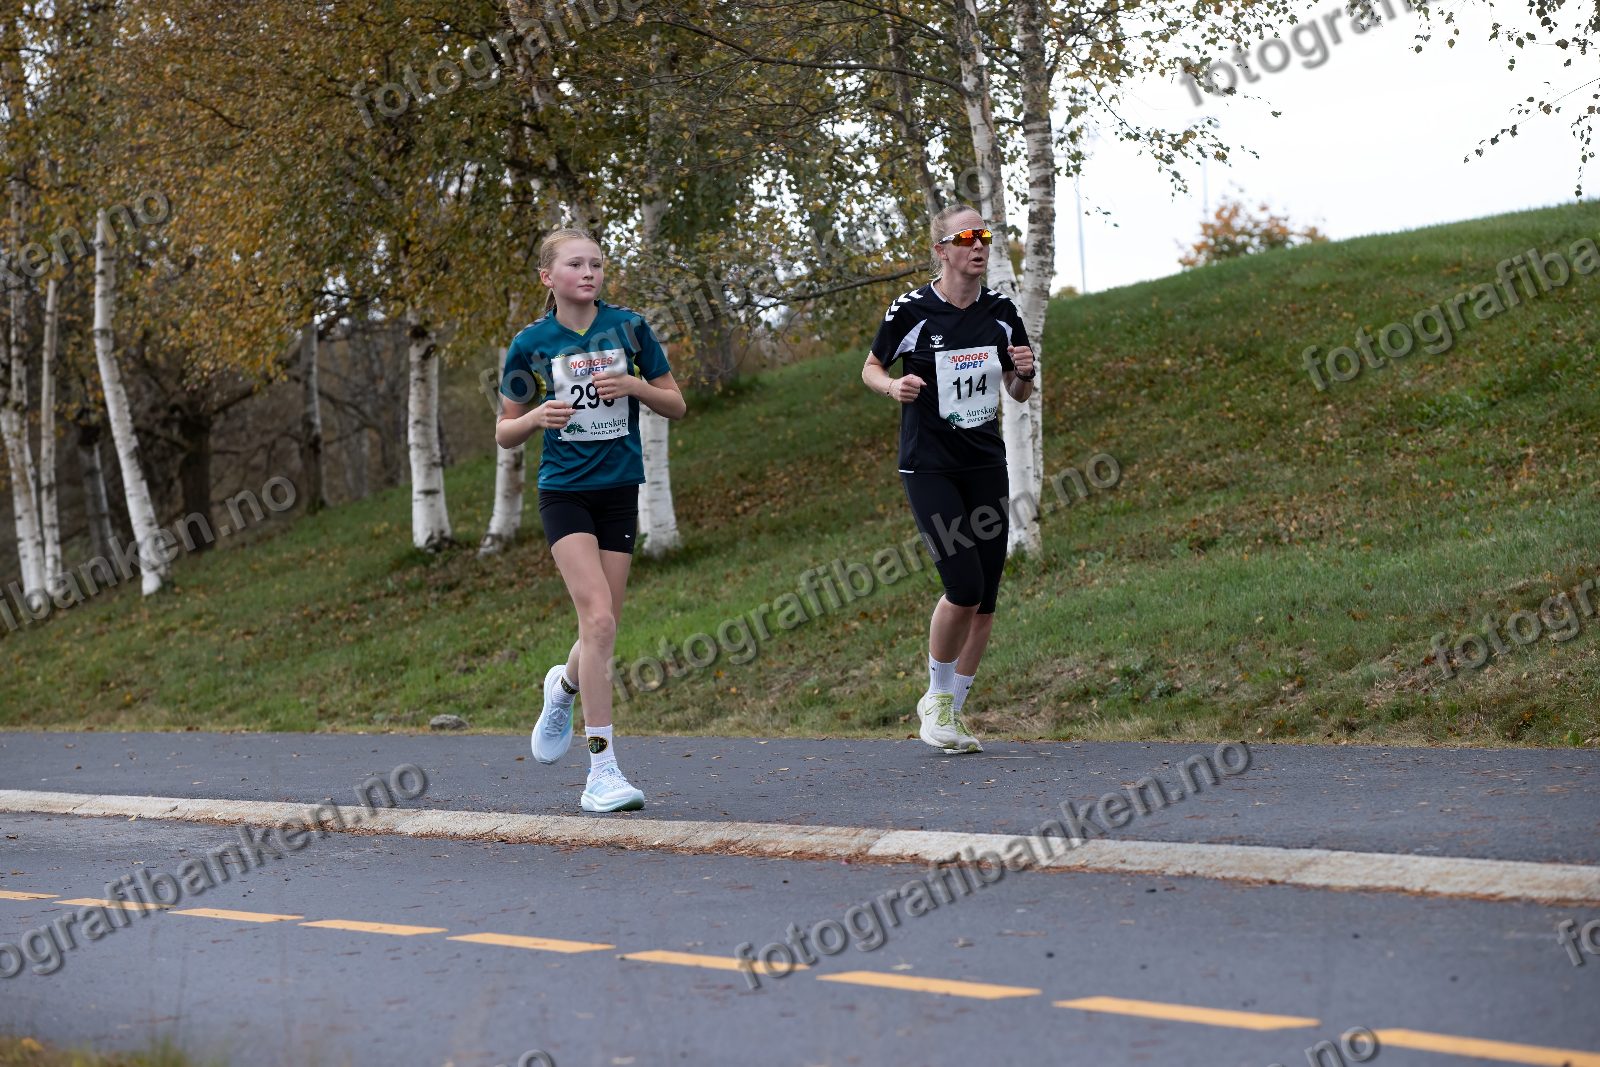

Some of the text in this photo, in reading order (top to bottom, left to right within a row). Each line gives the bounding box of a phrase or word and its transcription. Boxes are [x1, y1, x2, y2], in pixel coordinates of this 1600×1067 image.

[570, 357, 613, 369] NORGES
[951, 352, 989, 363] NORGES
[955, 360, 984, 370] LØPET
[952, 373, 987, 400] 114
